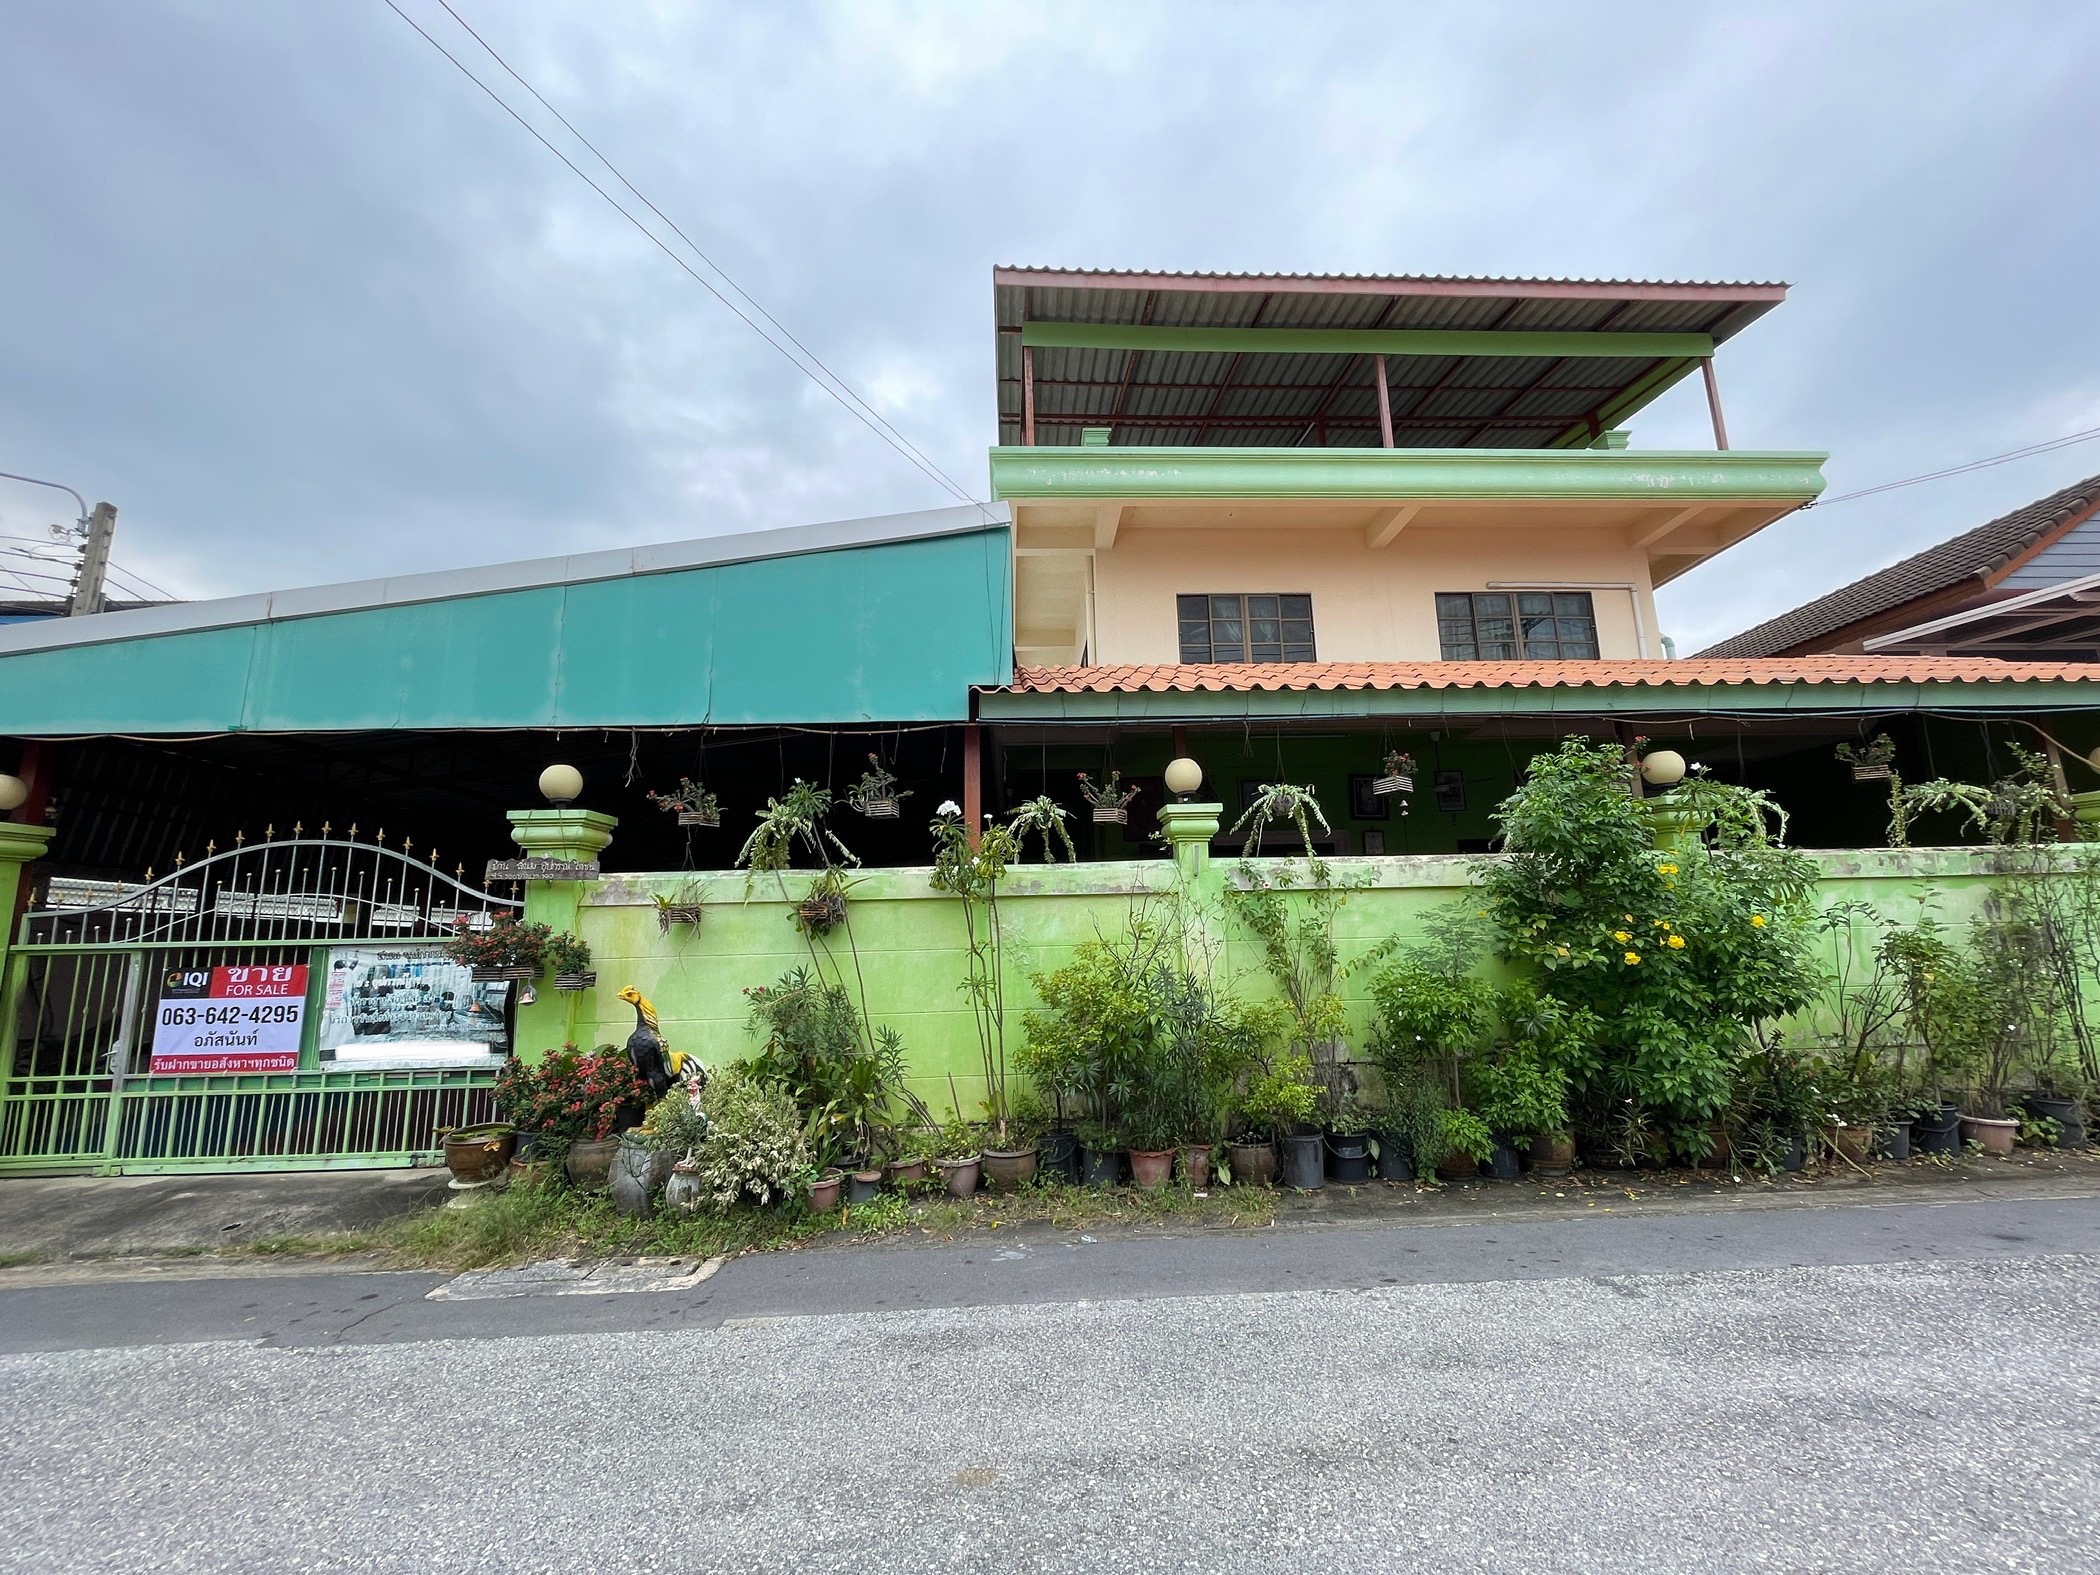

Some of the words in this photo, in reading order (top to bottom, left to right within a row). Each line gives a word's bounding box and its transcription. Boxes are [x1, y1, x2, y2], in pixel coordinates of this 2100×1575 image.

[183, 972, 209, 986] IQI
[227, 967, 293, 983] ขาย
[226, 984, 254, 996] FOR
[256, 983, 289, 995] SALE
[162, 1005, 299, 1025] 063-642-4295
[194, 1028, 260, 1047] อภัสนันท์
[153, 1056, 295, 1071] รับฝากขายอสังหาฯทุกชนิด
